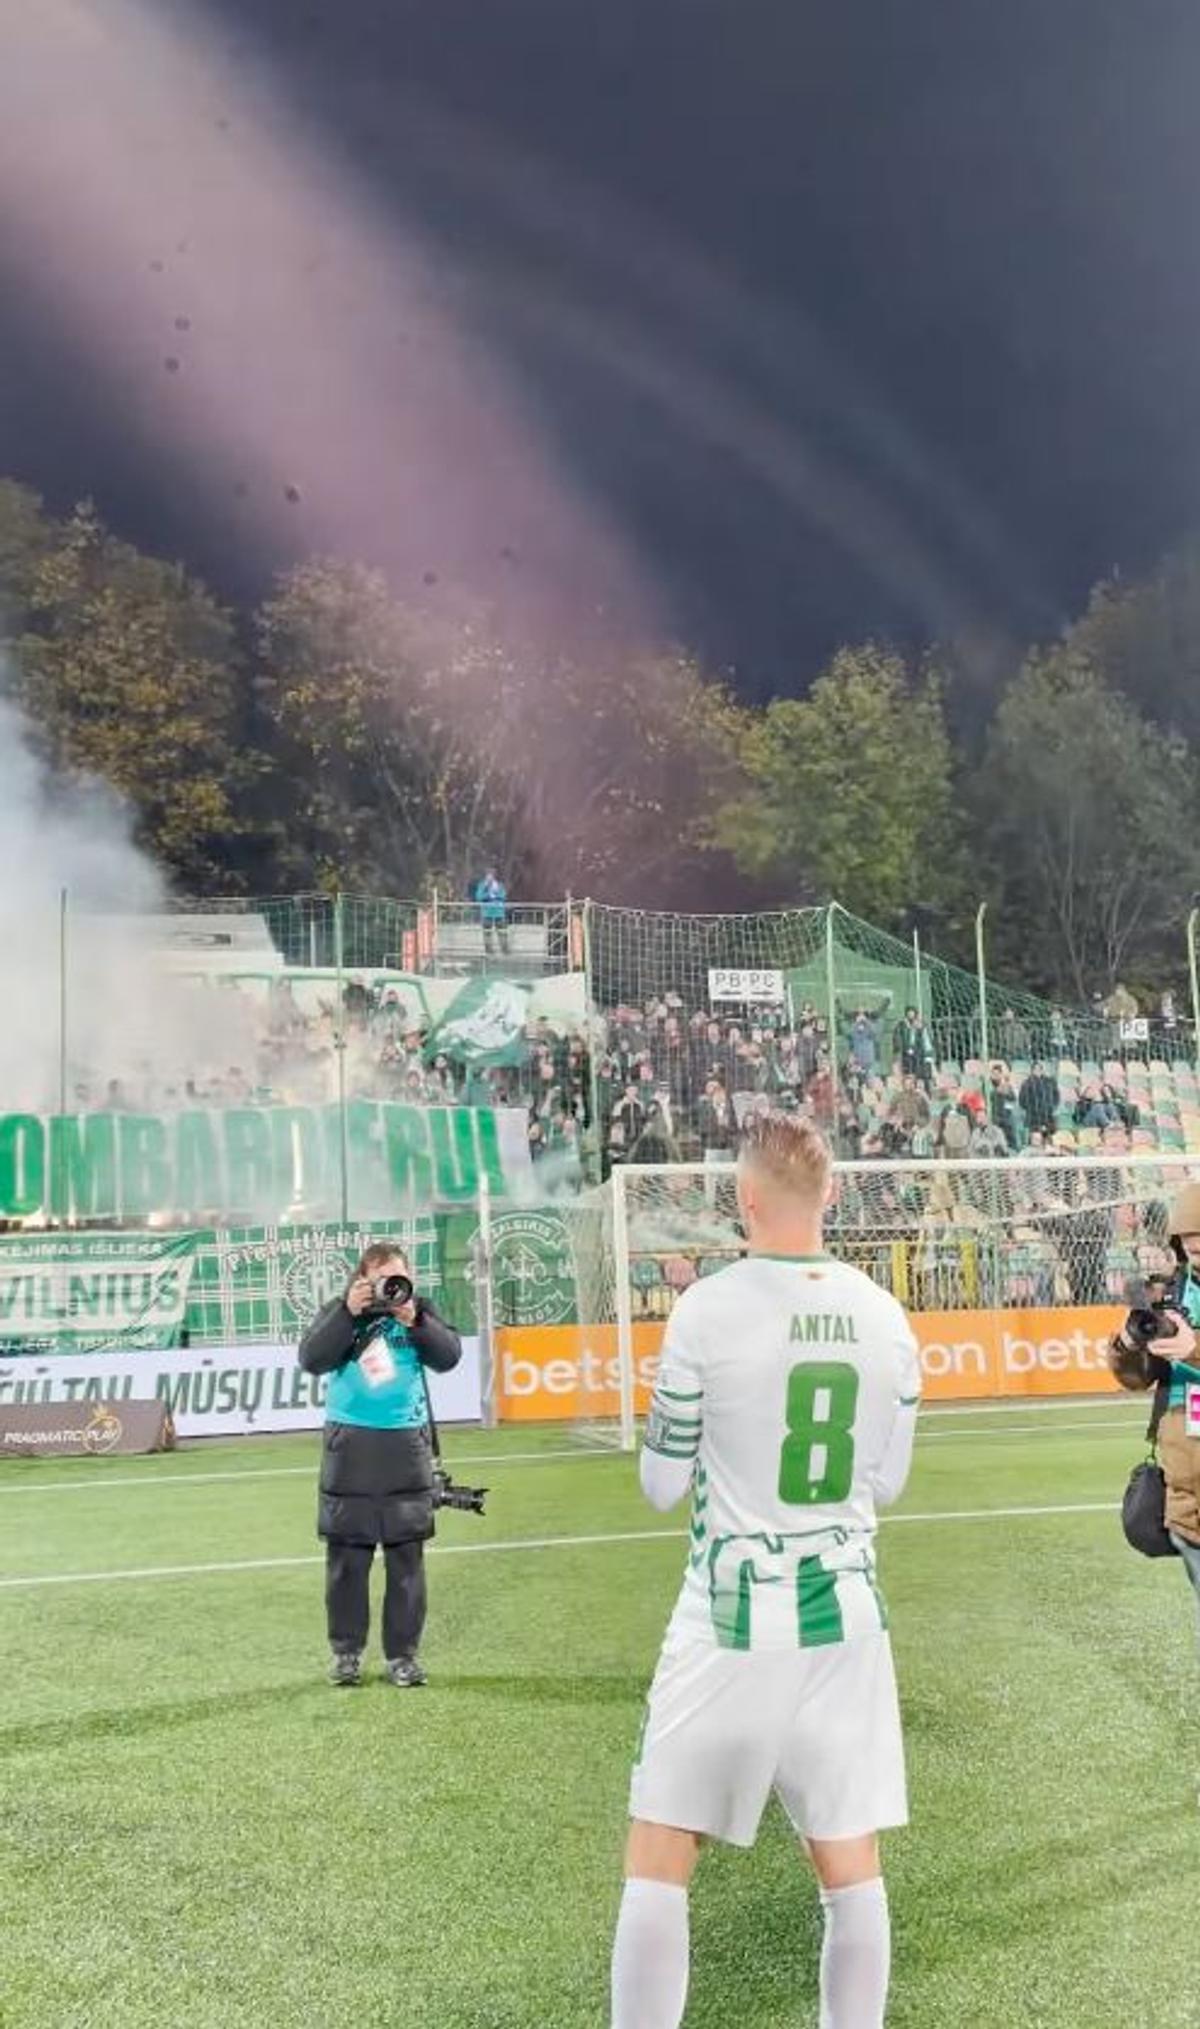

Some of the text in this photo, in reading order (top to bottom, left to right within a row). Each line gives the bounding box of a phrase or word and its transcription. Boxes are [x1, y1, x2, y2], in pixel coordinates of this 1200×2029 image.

[788, 1314, 860, 1343] ANTAL
[155, 1359, 266, 1424] MŪSŲ
[4, 1429, 118, 1444] PRAGMATIC PLAY
[778, 1361, 860, 1506] 8
